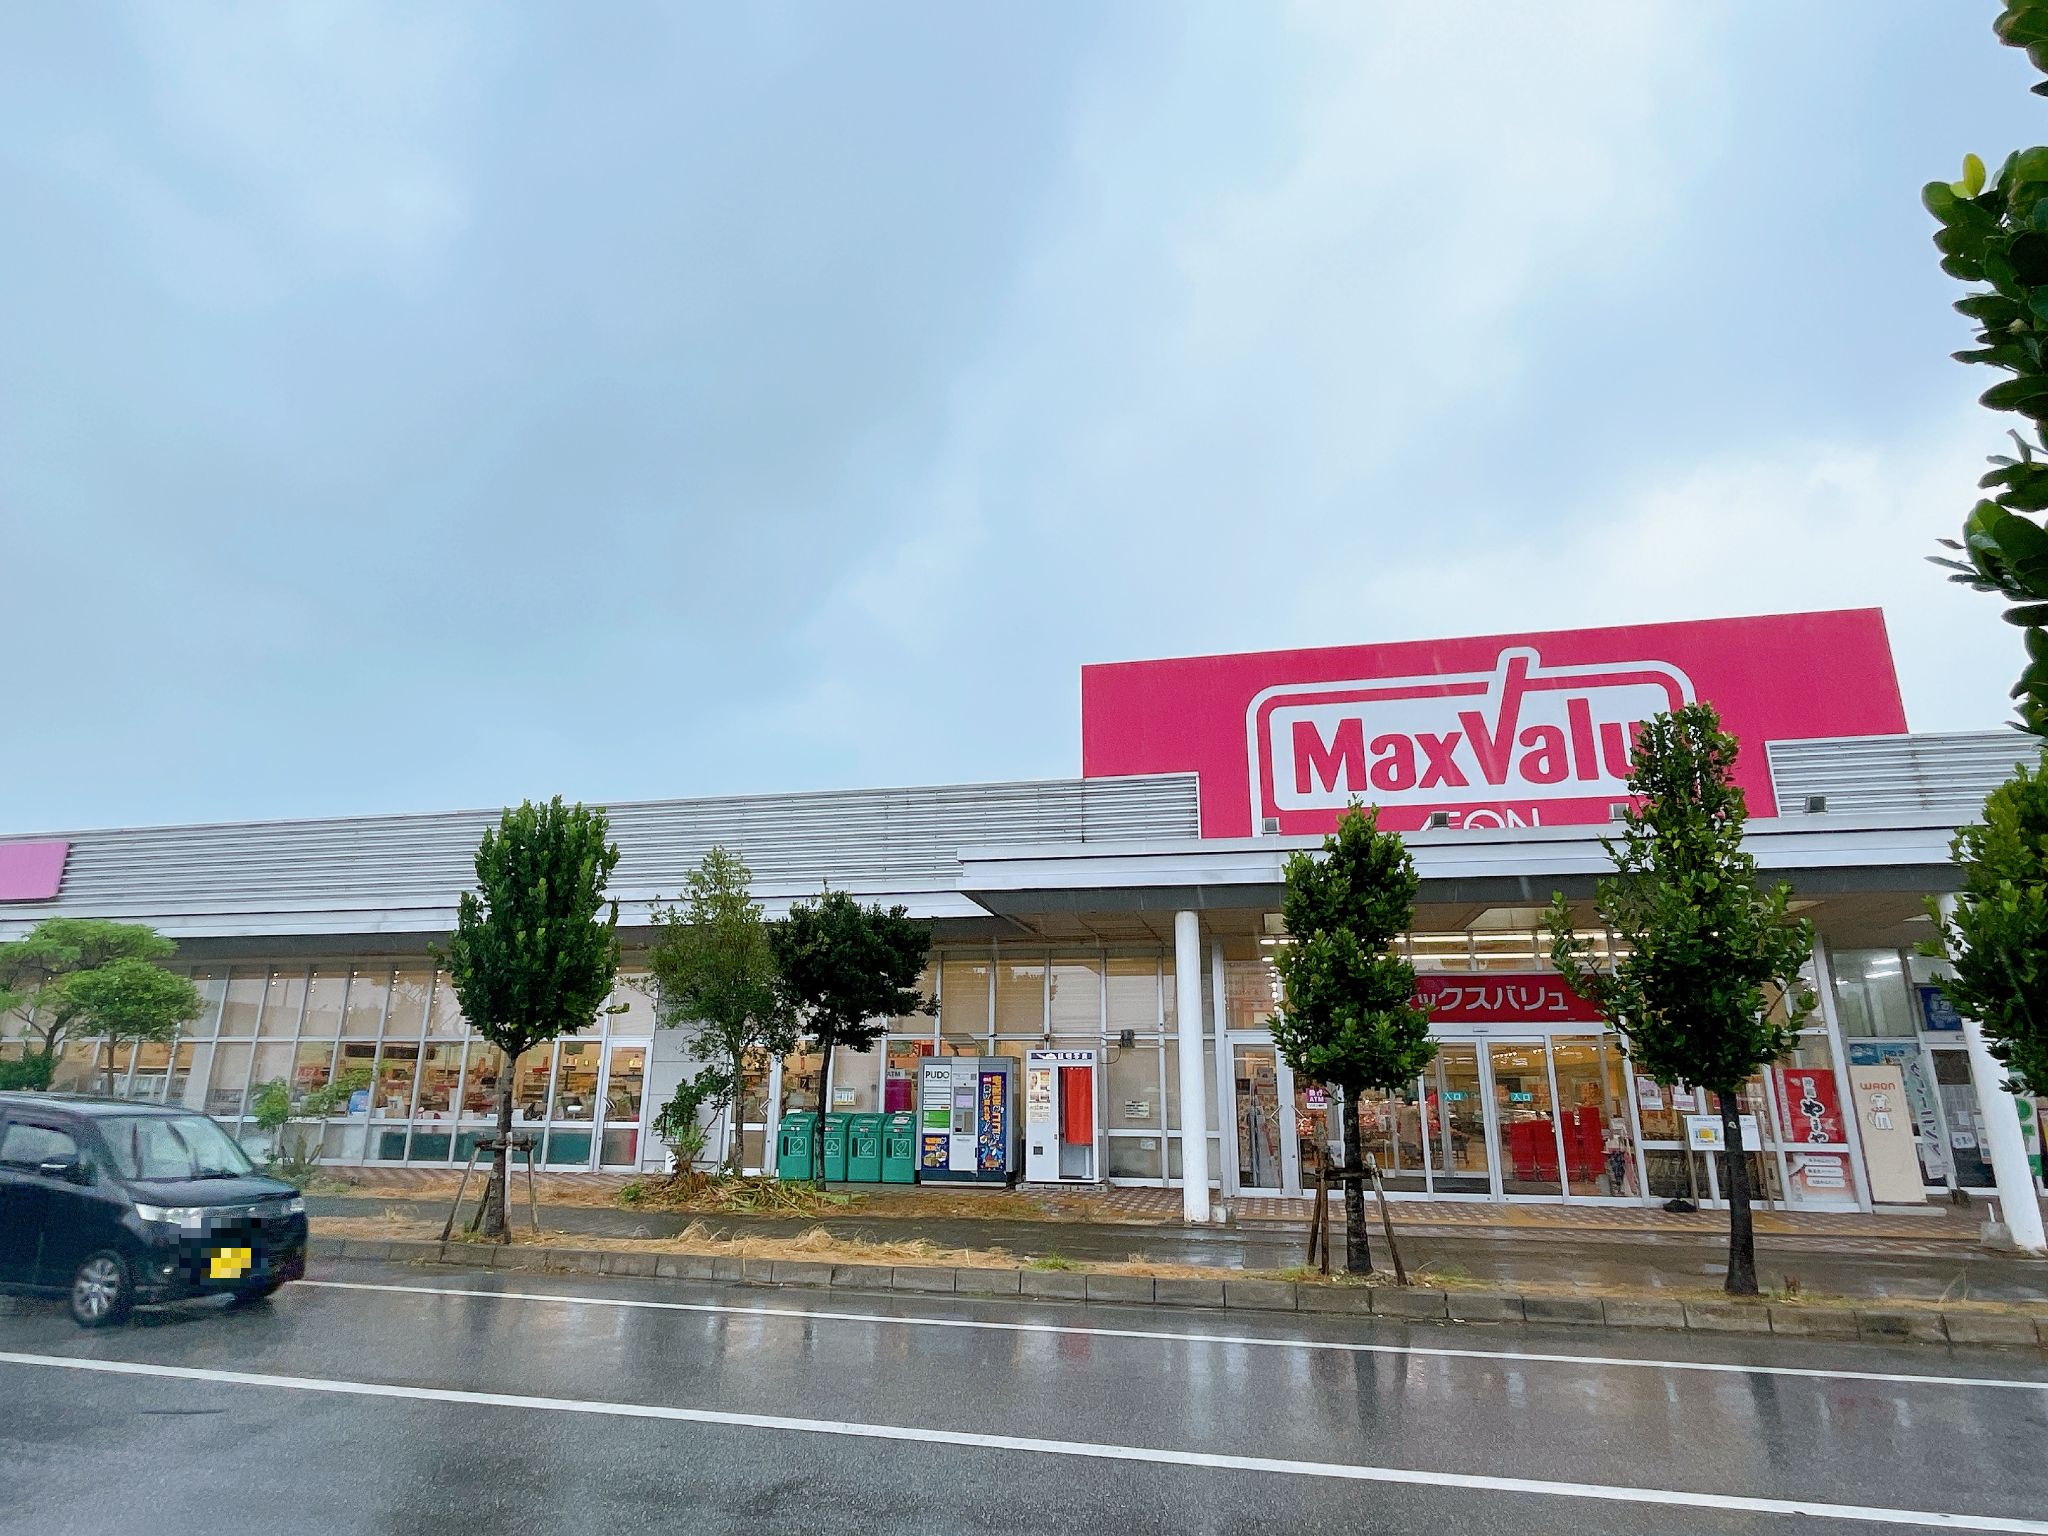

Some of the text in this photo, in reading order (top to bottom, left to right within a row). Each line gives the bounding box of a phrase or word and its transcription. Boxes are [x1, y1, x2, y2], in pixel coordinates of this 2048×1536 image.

[1409, 985, 1569, 1011] ックスバリュ
[925, 1071, 950, 1080] PUDO
[1859, 1082, 1897, 1091] WAON
[1444, 1093, 1462, 1101] 入口
[1513, 1094, 1531, 1102] 入口
